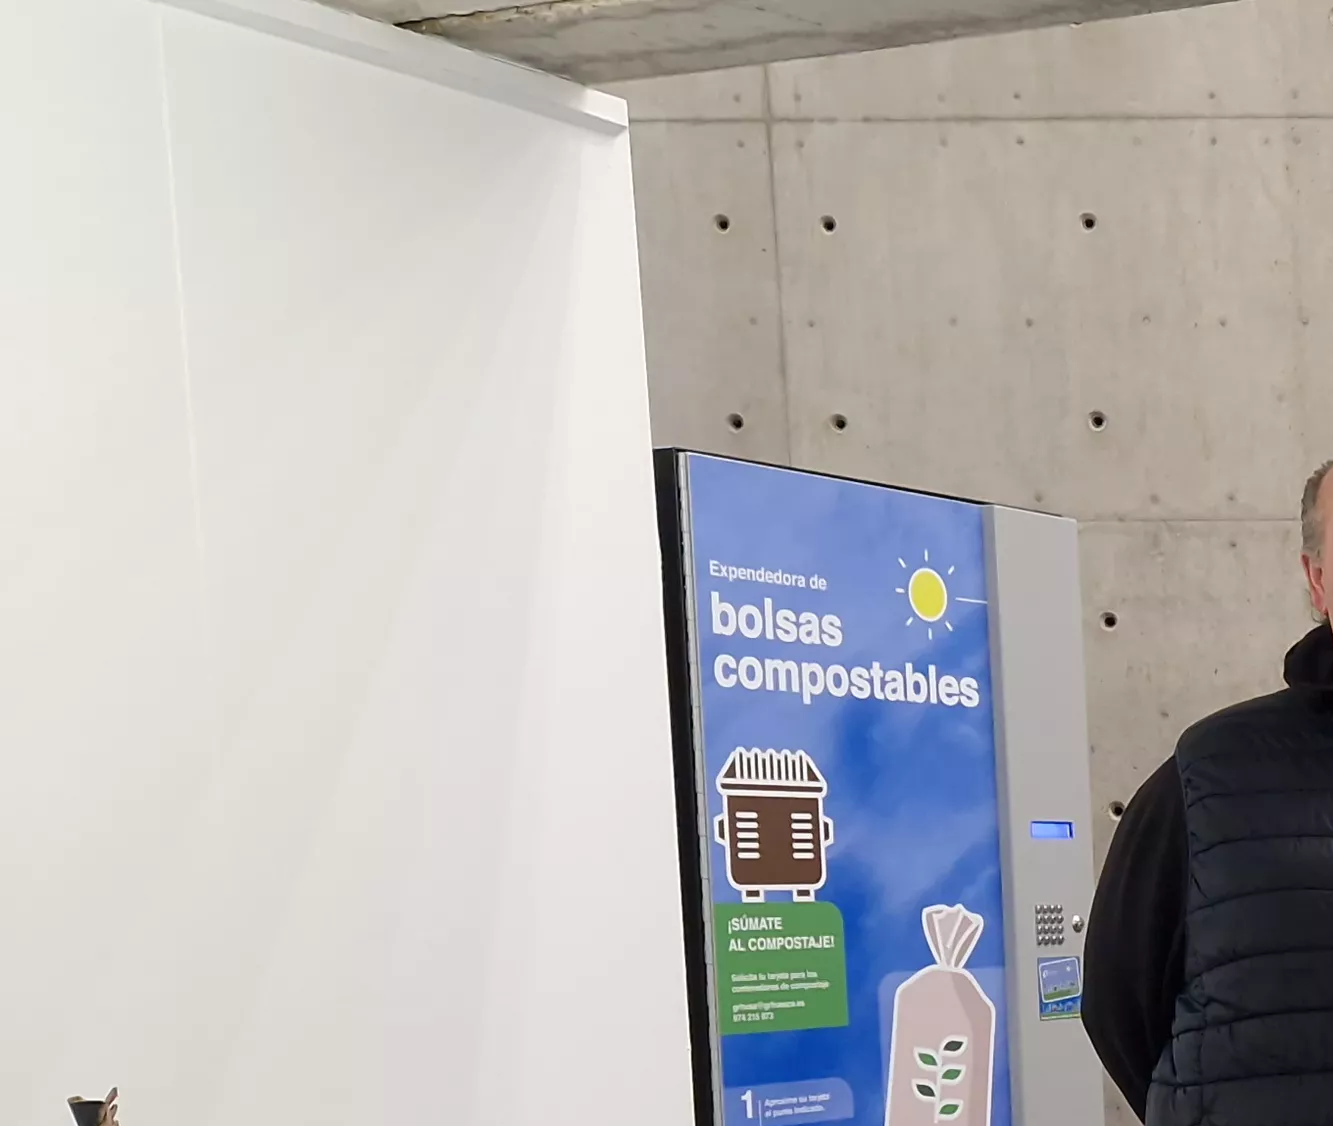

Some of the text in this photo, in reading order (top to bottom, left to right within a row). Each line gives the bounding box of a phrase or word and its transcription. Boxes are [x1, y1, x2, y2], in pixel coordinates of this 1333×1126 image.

[709, 560, 827, 590] Expendedora de
[710, 591, 843, 646] bolsas
[713, 653, 980, 708] compostables
[728, 914, 783, 934] ¡SÚMATE
[728, 935, 834, 951] AL COMPOSTAJE!
[741, 1089, 753, 1119] 1
